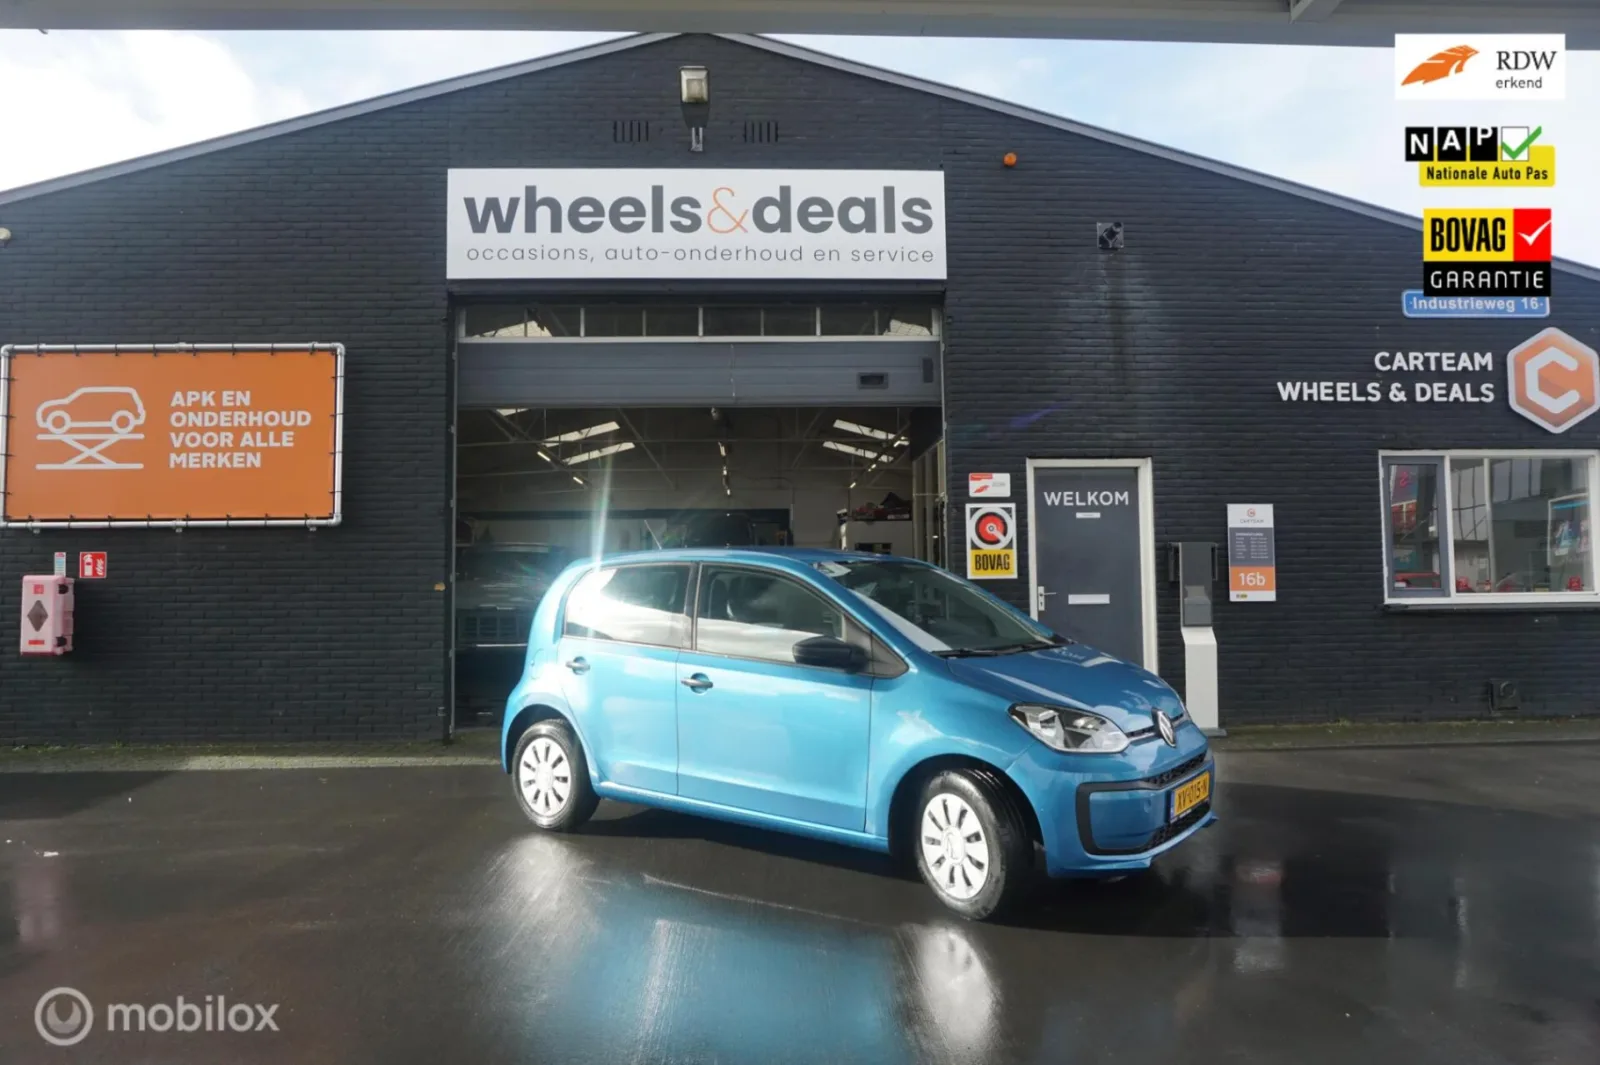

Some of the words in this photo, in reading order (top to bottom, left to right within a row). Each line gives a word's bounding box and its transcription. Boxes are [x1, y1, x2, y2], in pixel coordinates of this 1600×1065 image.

[467, 244, 595, 263] occasions,
[605, 244, 803, 263] auto-onderhoud
[814, 248, 841, 262] en
[851, 246, 935, 263] service
[1412, 297, 1516, 313] Industrieweg
[1521, 297, 1539, 310] 16
[1374, 351, 1494, 372] CARTEAM
[170, 390, 216, 407] APK
[222, 390, 251, 406] EN
[1277, 381, 1381, 402] WHEELS
[1389, 382, 1407, 402] &
[1415, 382, 1495, 403] DEALS
[170, 410, 312, 427] ONDERHOUD
[170, 431, 234, 448] VOOR
[239, 431, 295, 448] ALLE
[169, 451, 261, 469] MERKEN
[1043, 490, 1130, 507] WELKOM
[974, 553, 1010, 571] BOVAG
[1238, 572, 1266, 587] 16b
